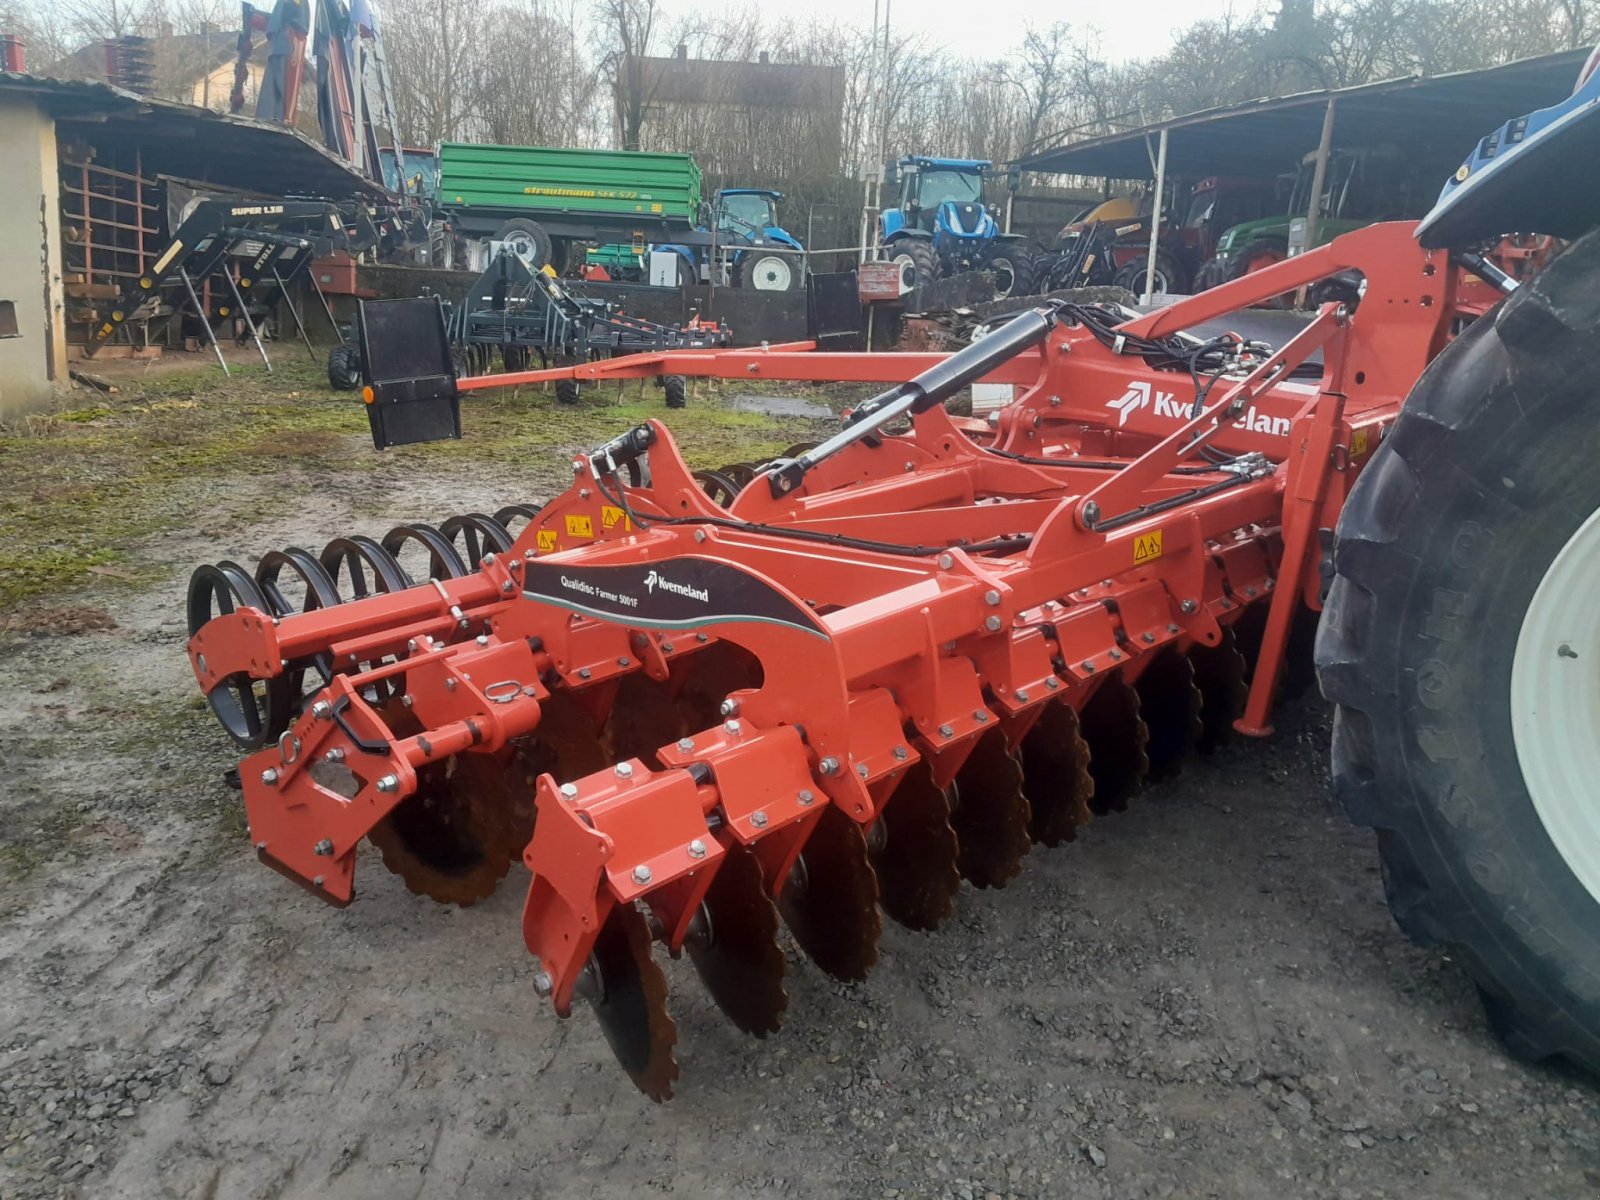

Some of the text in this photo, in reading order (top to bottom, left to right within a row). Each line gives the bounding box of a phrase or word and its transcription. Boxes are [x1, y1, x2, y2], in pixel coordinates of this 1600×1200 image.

[231, 206, 262, 216] SUPER
[253, 243, 276, 271] STOLL
[560, 575, 639, 608] Qualidisc Farmer 5001F
[658, 575, 709, 603] Kverneland
